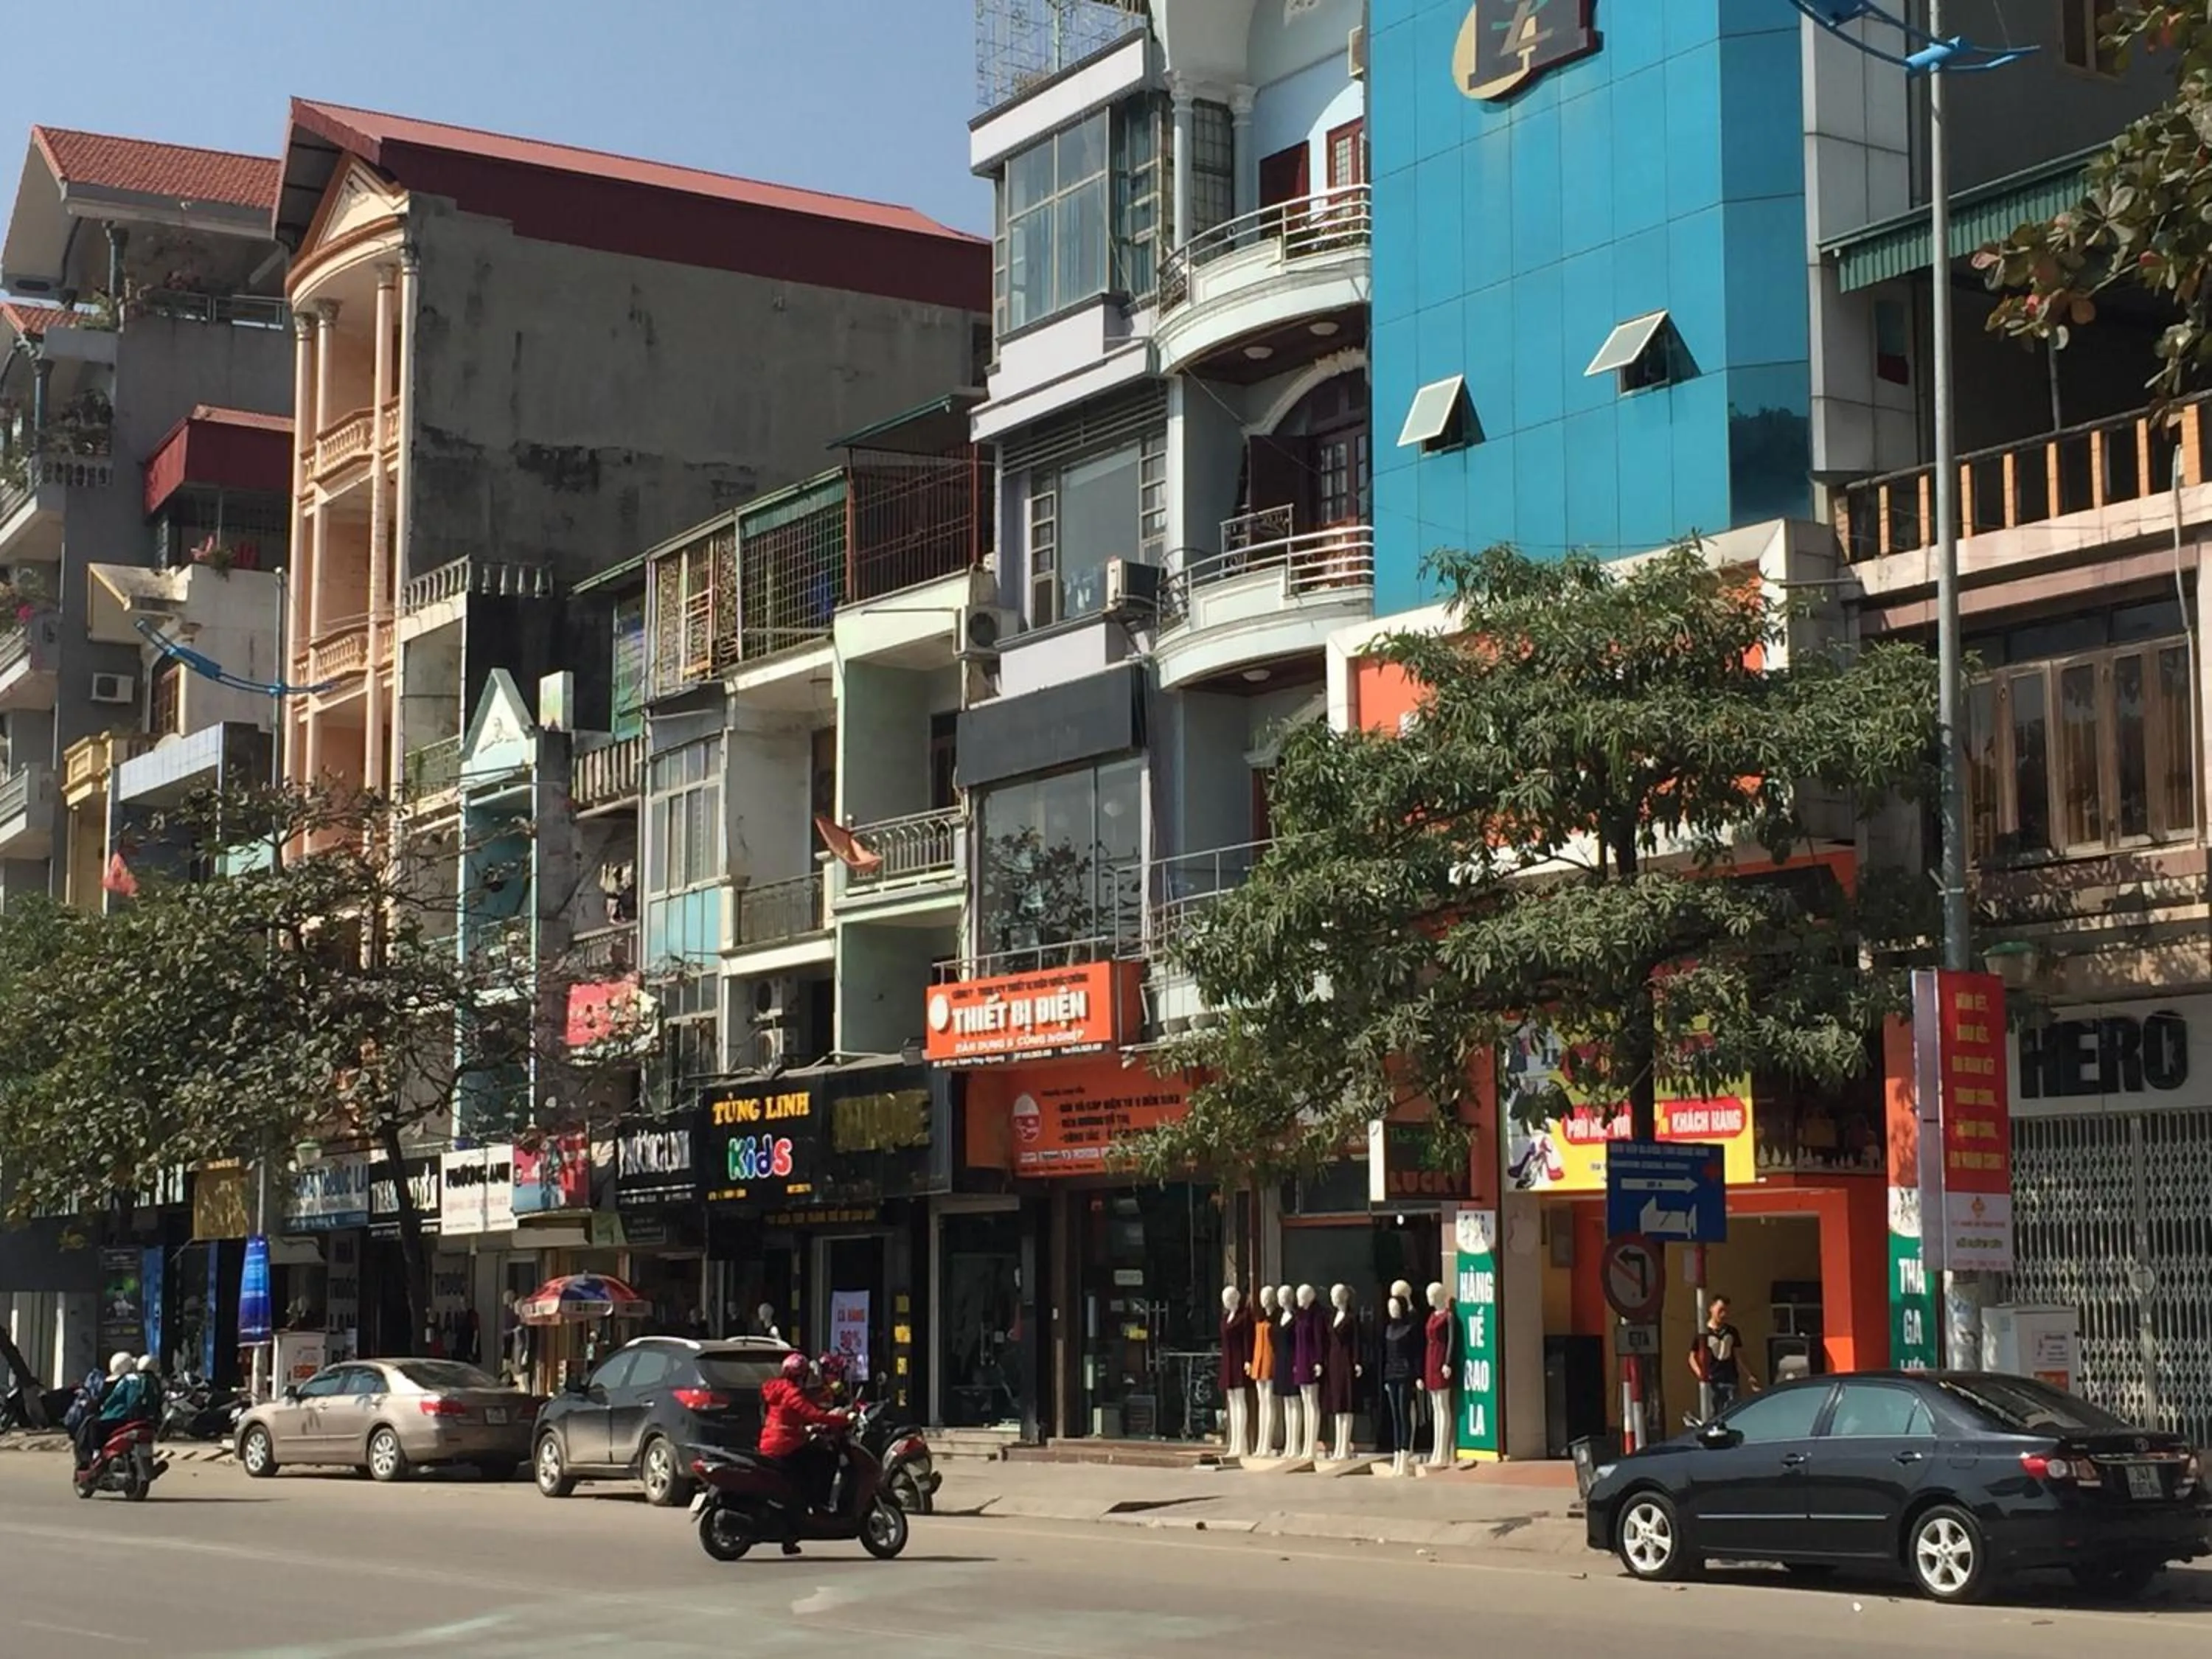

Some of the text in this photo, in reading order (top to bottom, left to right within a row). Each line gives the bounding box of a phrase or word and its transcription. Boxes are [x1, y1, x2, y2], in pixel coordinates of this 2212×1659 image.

[1011, 998, 1032, 1032] BỊ
[765, 1091, 811, 1120] LINH
[728, 1133, 793, 1181] Kids
[1459, 1265, 1494, 1304] HÀNG
[1463, 1359, 1490, 1392] BAO
[1468, 1403, 1486, 1436] LA
